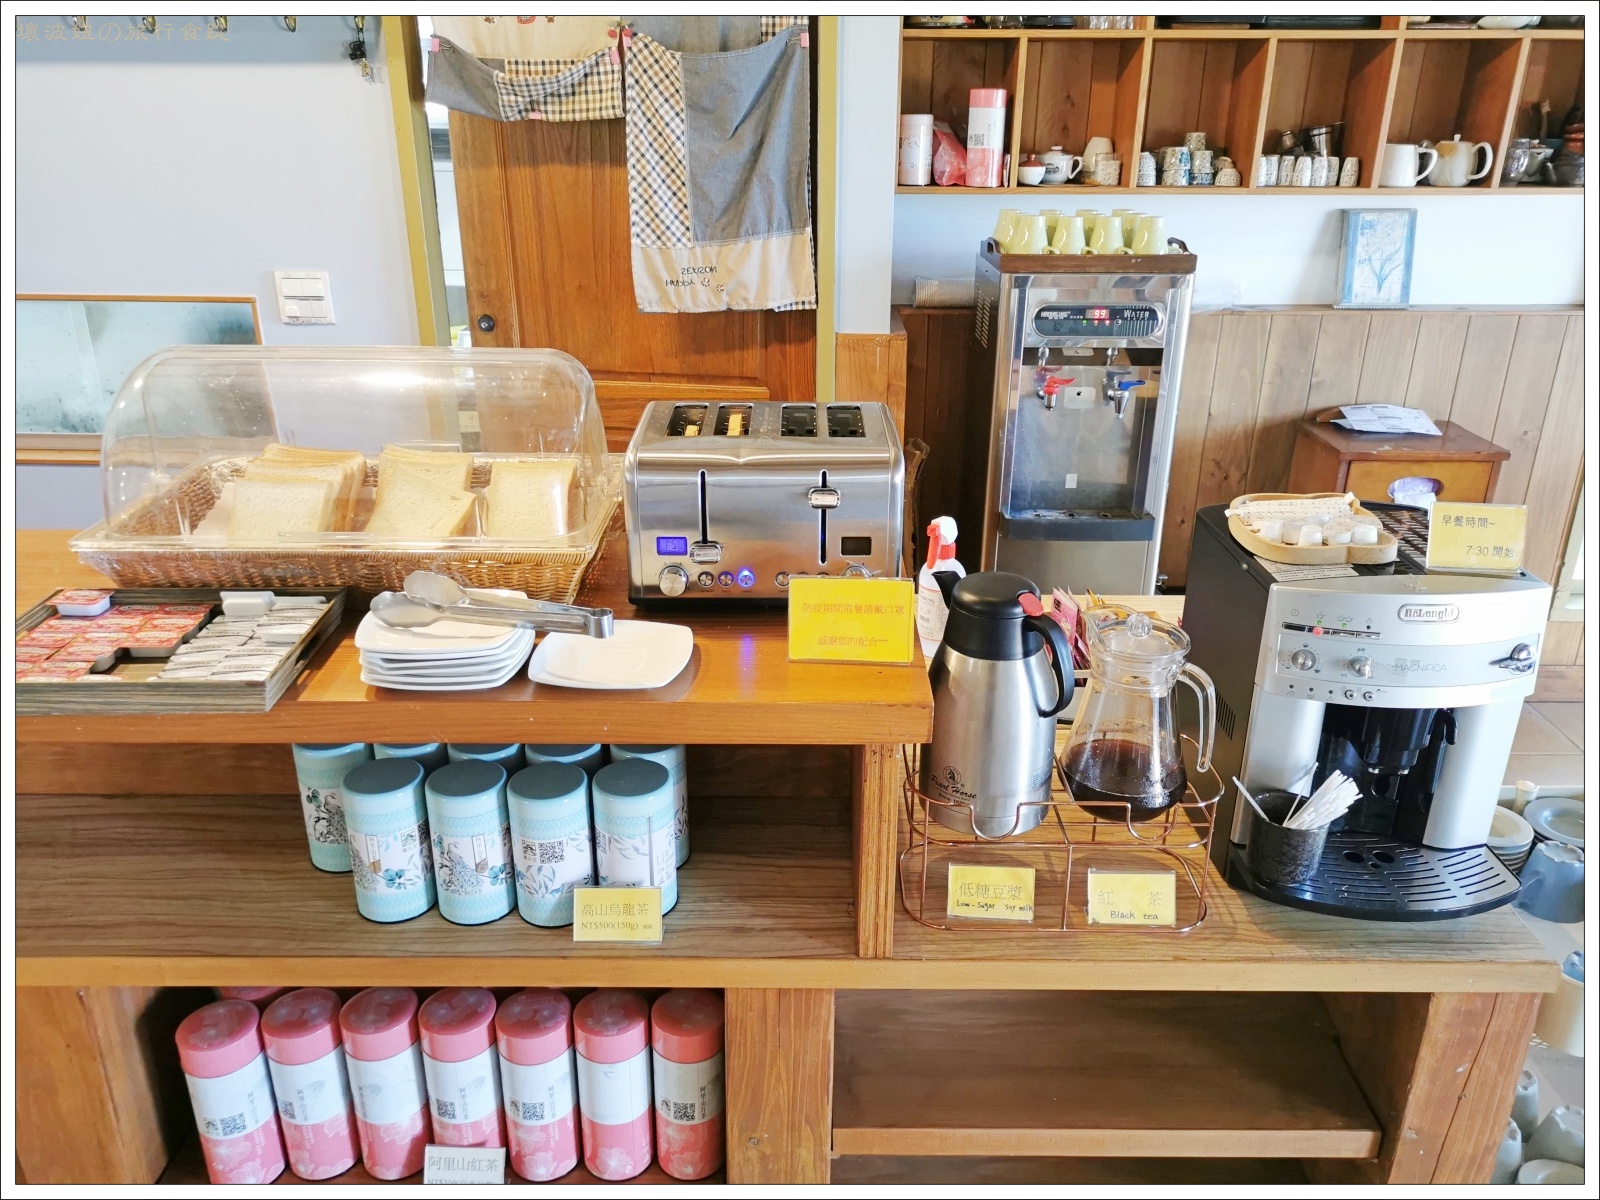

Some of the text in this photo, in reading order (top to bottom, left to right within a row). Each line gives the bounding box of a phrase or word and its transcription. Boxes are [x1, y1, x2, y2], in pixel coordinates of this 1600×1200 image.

[1094, 309, 1106, 318] 99
[1466, 545, 1515, 558] 7:30 開始
[1395, 663, 1448, 672] MAGNIFICA
[931, 775, 950, 791] Pearl
[951, 786, 977, 799] Horse
[959, 882, 1022, 900] 低糖豆漿
[581, 903, 649, 917] 高山烏龍茶
[1110, 910, 1136, 920] Black
[581, 921, 639, 931] NT$500(150g)
[428, 1156, 500, 1172] 阿里山紅茶
